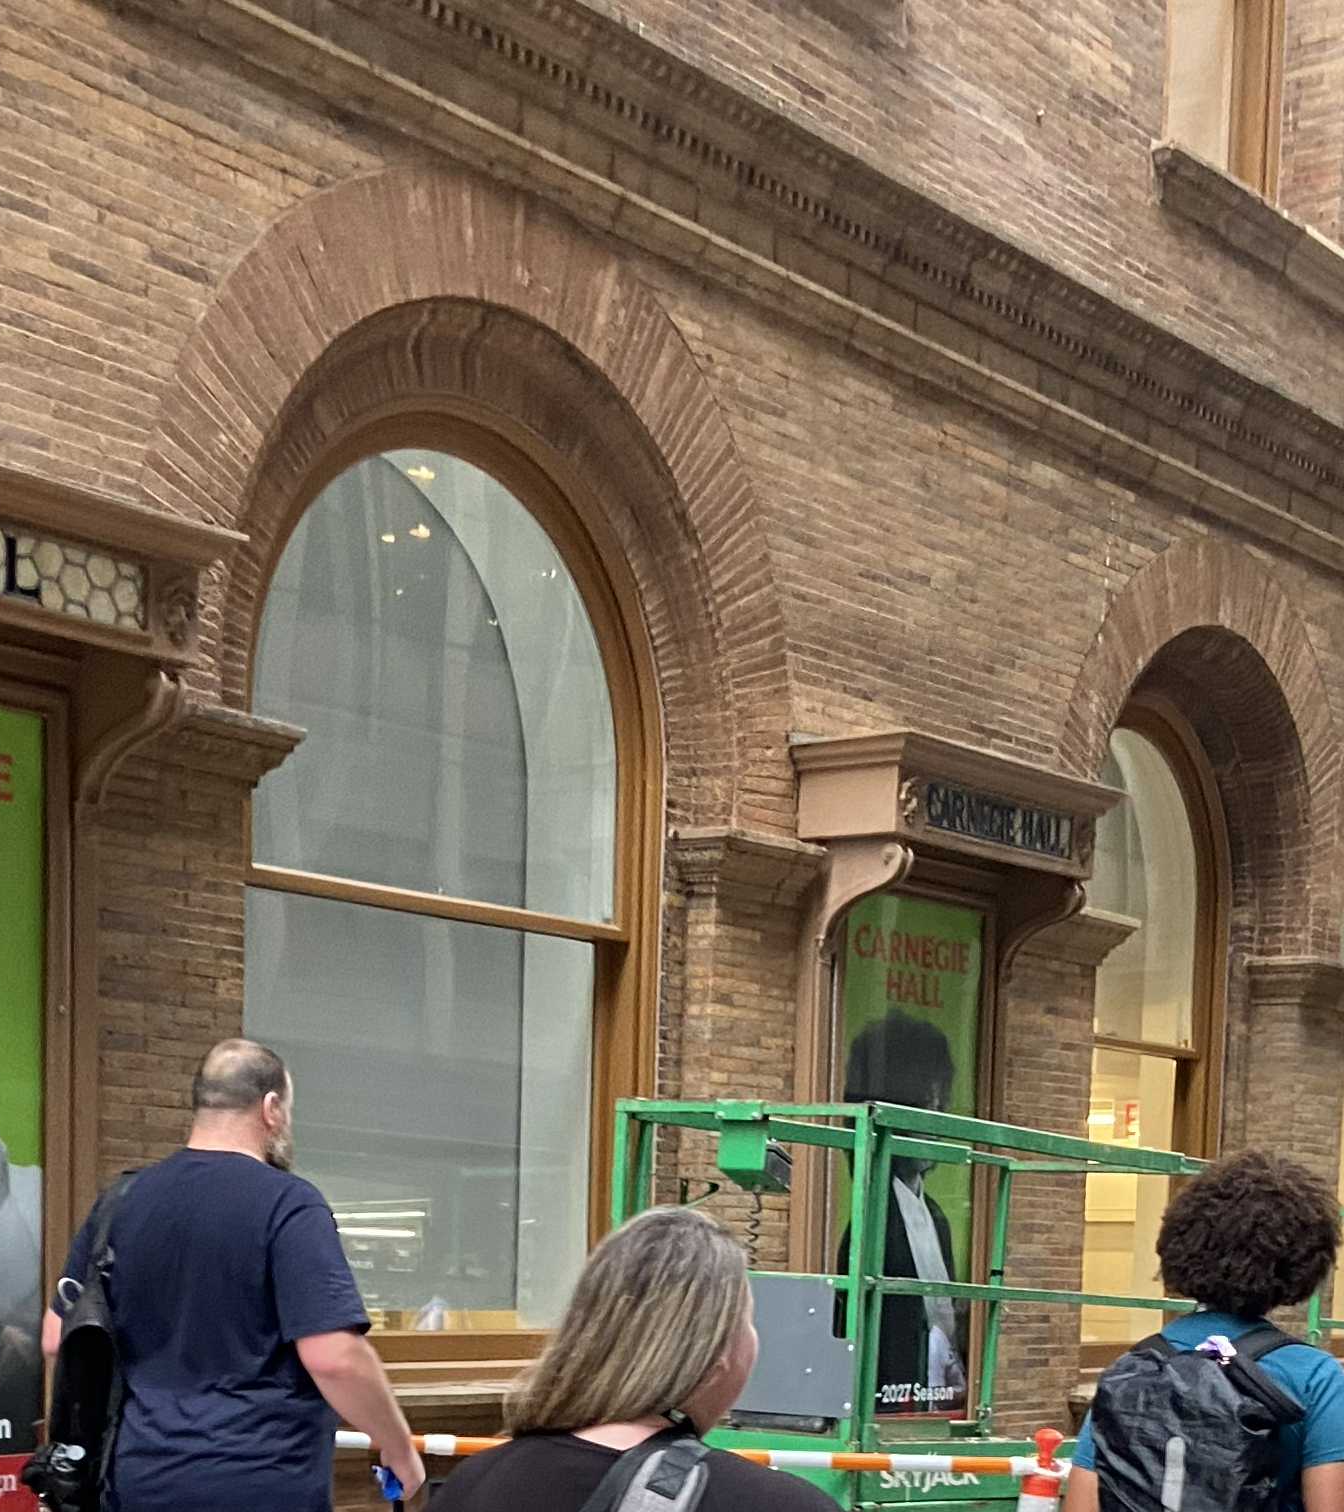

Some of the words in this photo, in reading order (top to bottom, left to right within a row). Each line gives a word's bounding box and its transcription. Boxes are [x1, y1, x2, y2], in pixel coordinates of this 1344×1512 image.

[927, 783, 1015, 847] CARNEGIE
[1022, 808, 1068, 857] HALL
[854, 924, 969, 974] CARNEGIE
[885, 967, 945, 1009] HALL
[913, 1382, 954, 1402] Season
[880, 1467, 980, 1493] SKYJACK
